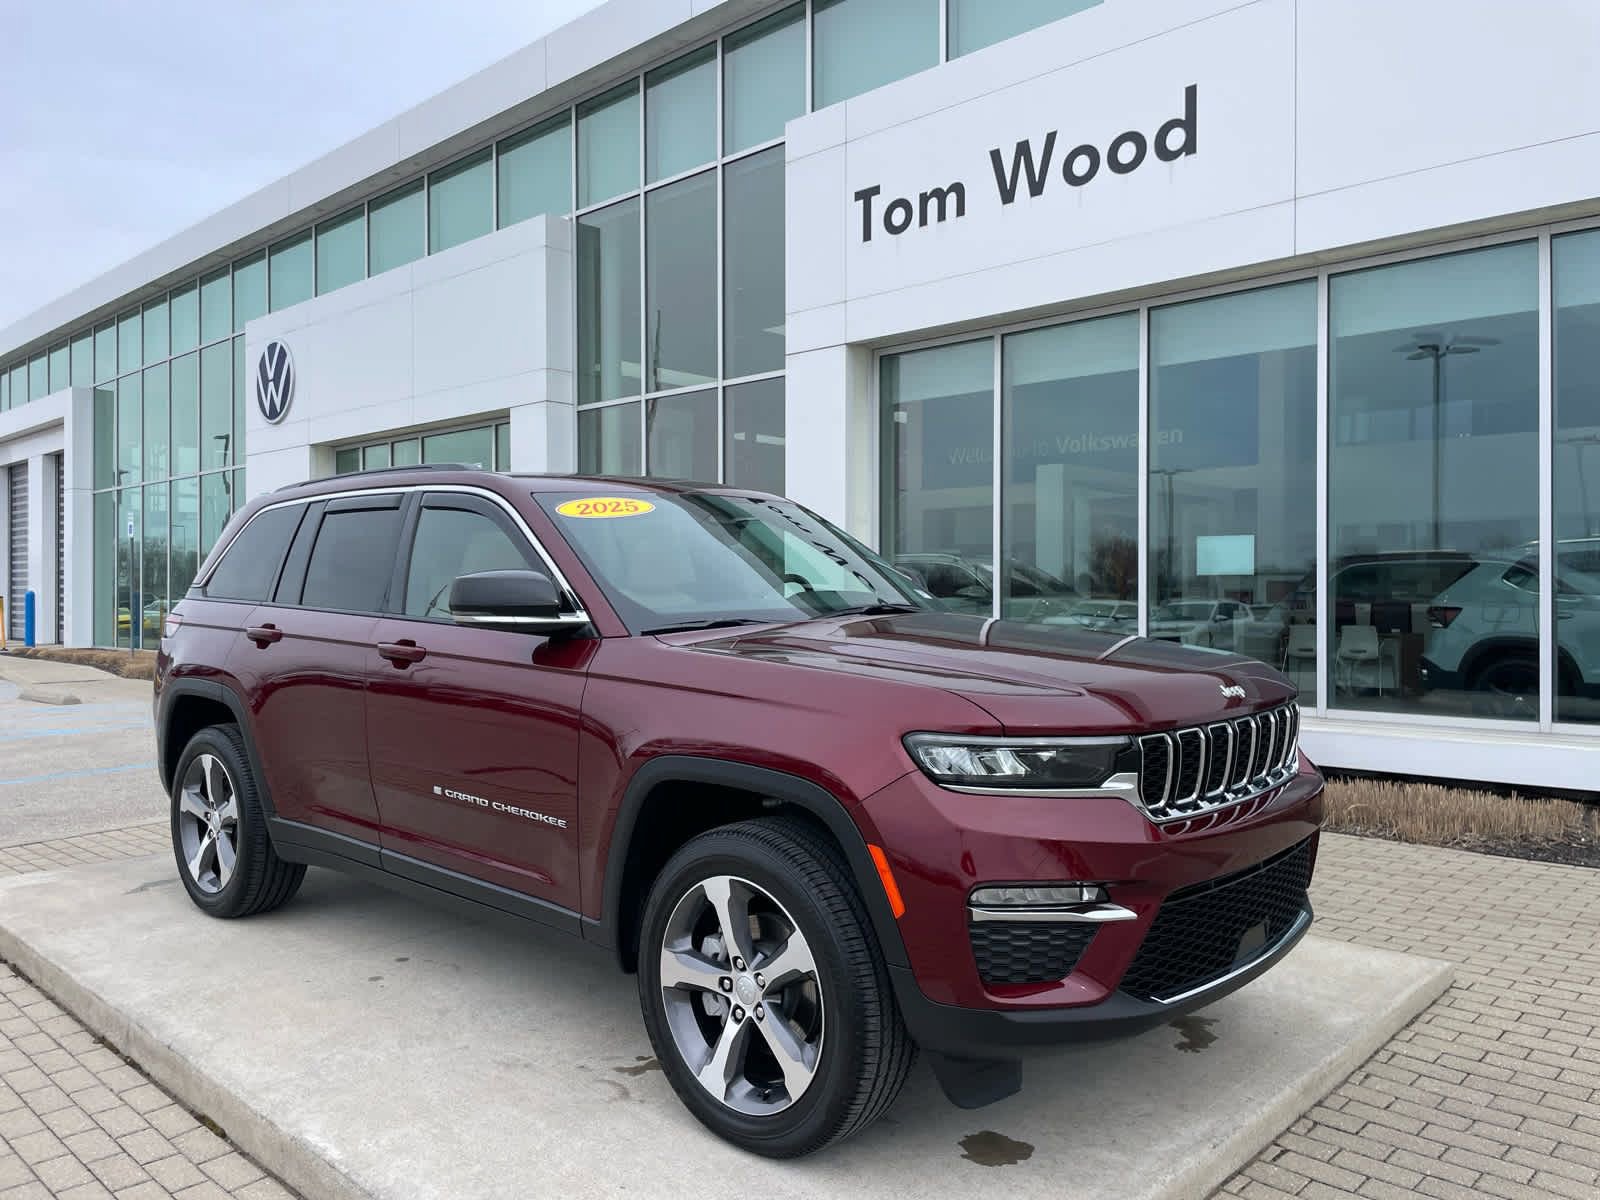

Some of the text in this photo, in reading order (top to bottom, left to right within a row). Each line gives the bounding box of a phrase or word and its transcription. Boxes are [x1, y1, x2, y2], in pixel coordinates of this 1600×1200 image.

[854, 83, 1198, 243] Tom Wood
[1056, 428, 1184, 454] Volkswaen
[576, 501, 639, 515] 2025
[444, 789, 568, 829] GRAND CHEROKEE
